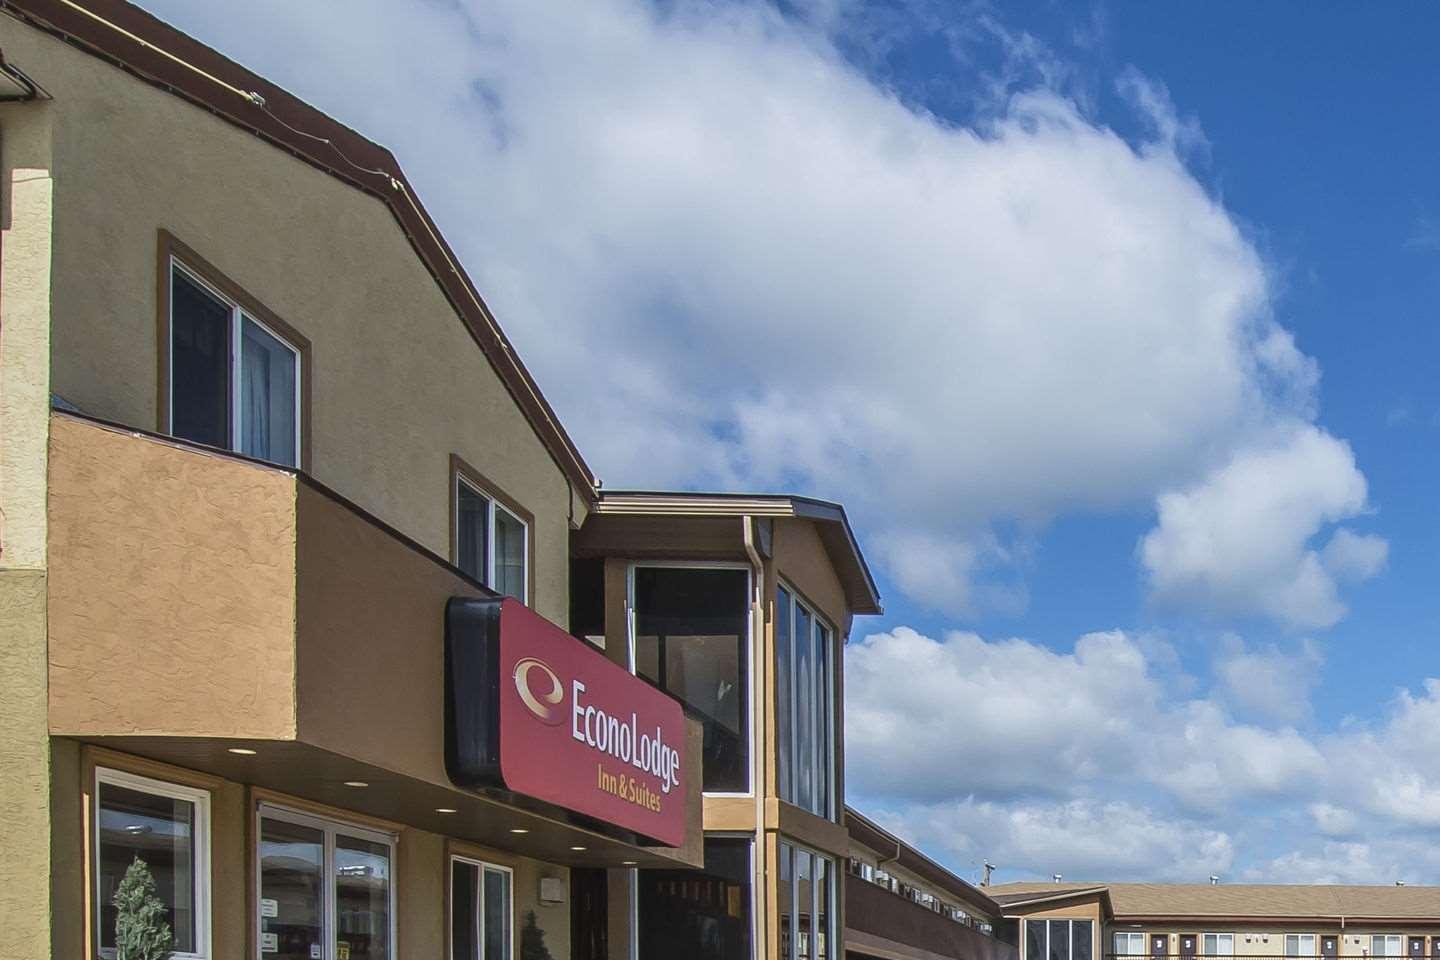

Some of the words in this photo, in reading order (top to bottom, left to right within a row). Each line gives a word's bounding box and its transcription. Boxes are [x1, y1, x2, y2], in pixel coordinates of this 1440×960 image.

[572, 679, 680, 793] EconoLodge
[598, 763, 617, 795] Inn
[629, 778, 661, 813] Suites
